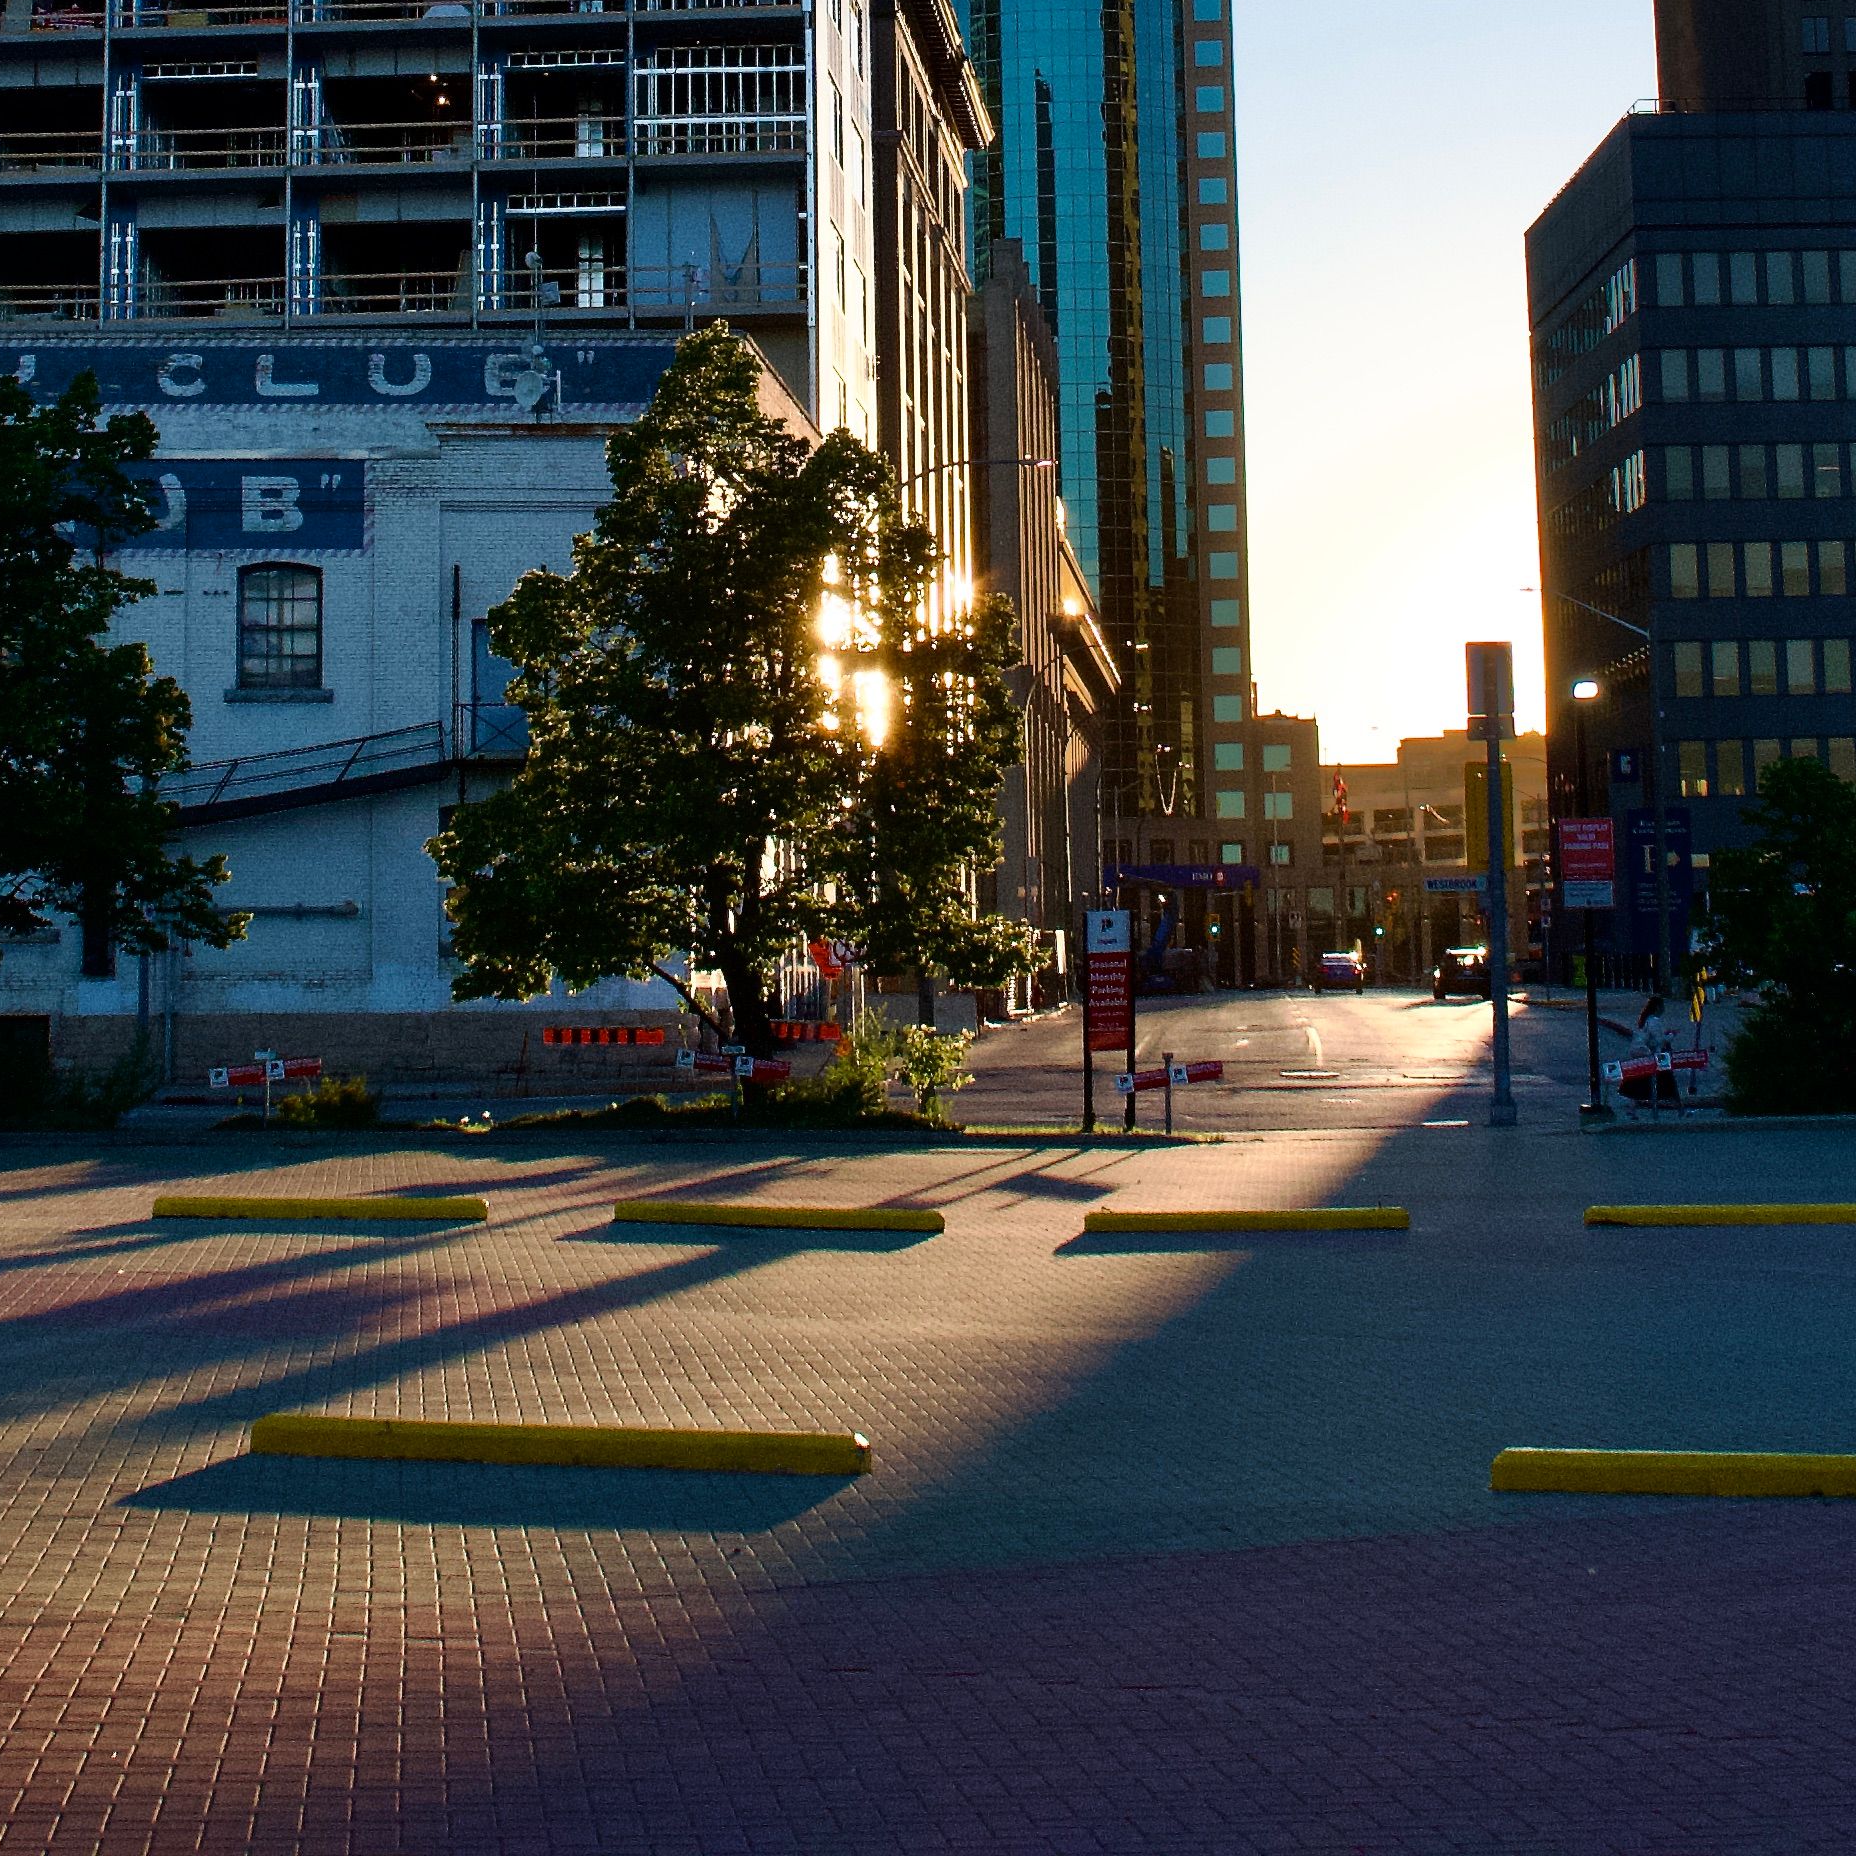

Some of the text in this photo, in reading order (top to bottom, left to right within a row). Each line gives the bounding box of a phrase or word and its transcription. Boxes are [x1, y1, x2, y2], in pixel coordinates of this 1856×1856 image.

[1089, 959, 1127, 969] Seasonal
[1090, 972, 1126, 982] Monthly
[1090, 985, 1125, 996] Parking
[1088, 998, 1128, 1007] Available
